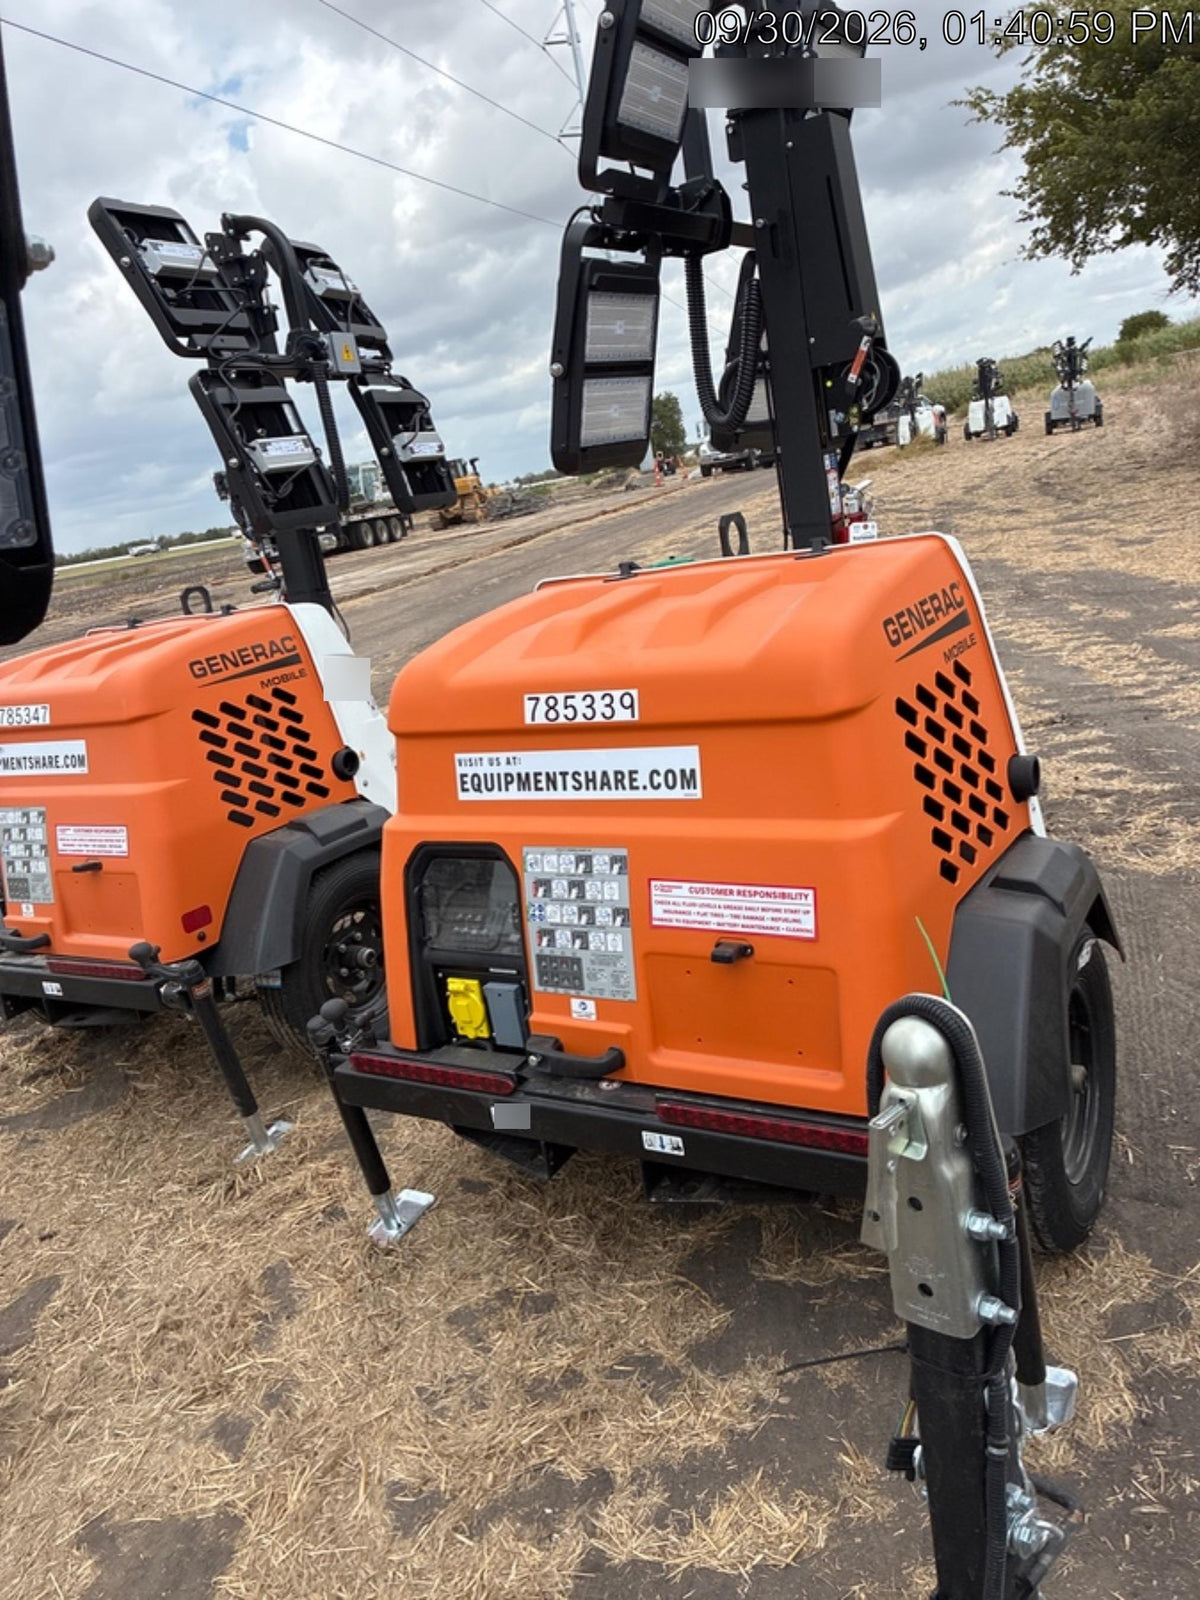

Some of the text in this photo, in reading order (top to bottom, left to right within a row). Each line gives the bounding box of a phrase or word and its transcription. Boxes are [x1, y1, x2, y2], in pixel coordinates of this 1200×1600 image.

[882, 582, 965, 648] GENERAC
[188, 636, 297, 679] GENERAC
[943, 632, 977, 664] MOBILE
[260, 668, 307, 689] MOBILE
[527, 691, 636, 722] 785339
[0, 754, 86, 771] MENTSHARE.COM
[457, 756, 522, 767] VISIT US AT:
[459, 768, 698, 793] EQUIPMENTSHARE.COM
[688, 886, 734, 897] CUSTOMER
[736, 888, 809, 901] RESPONSIBILITY
